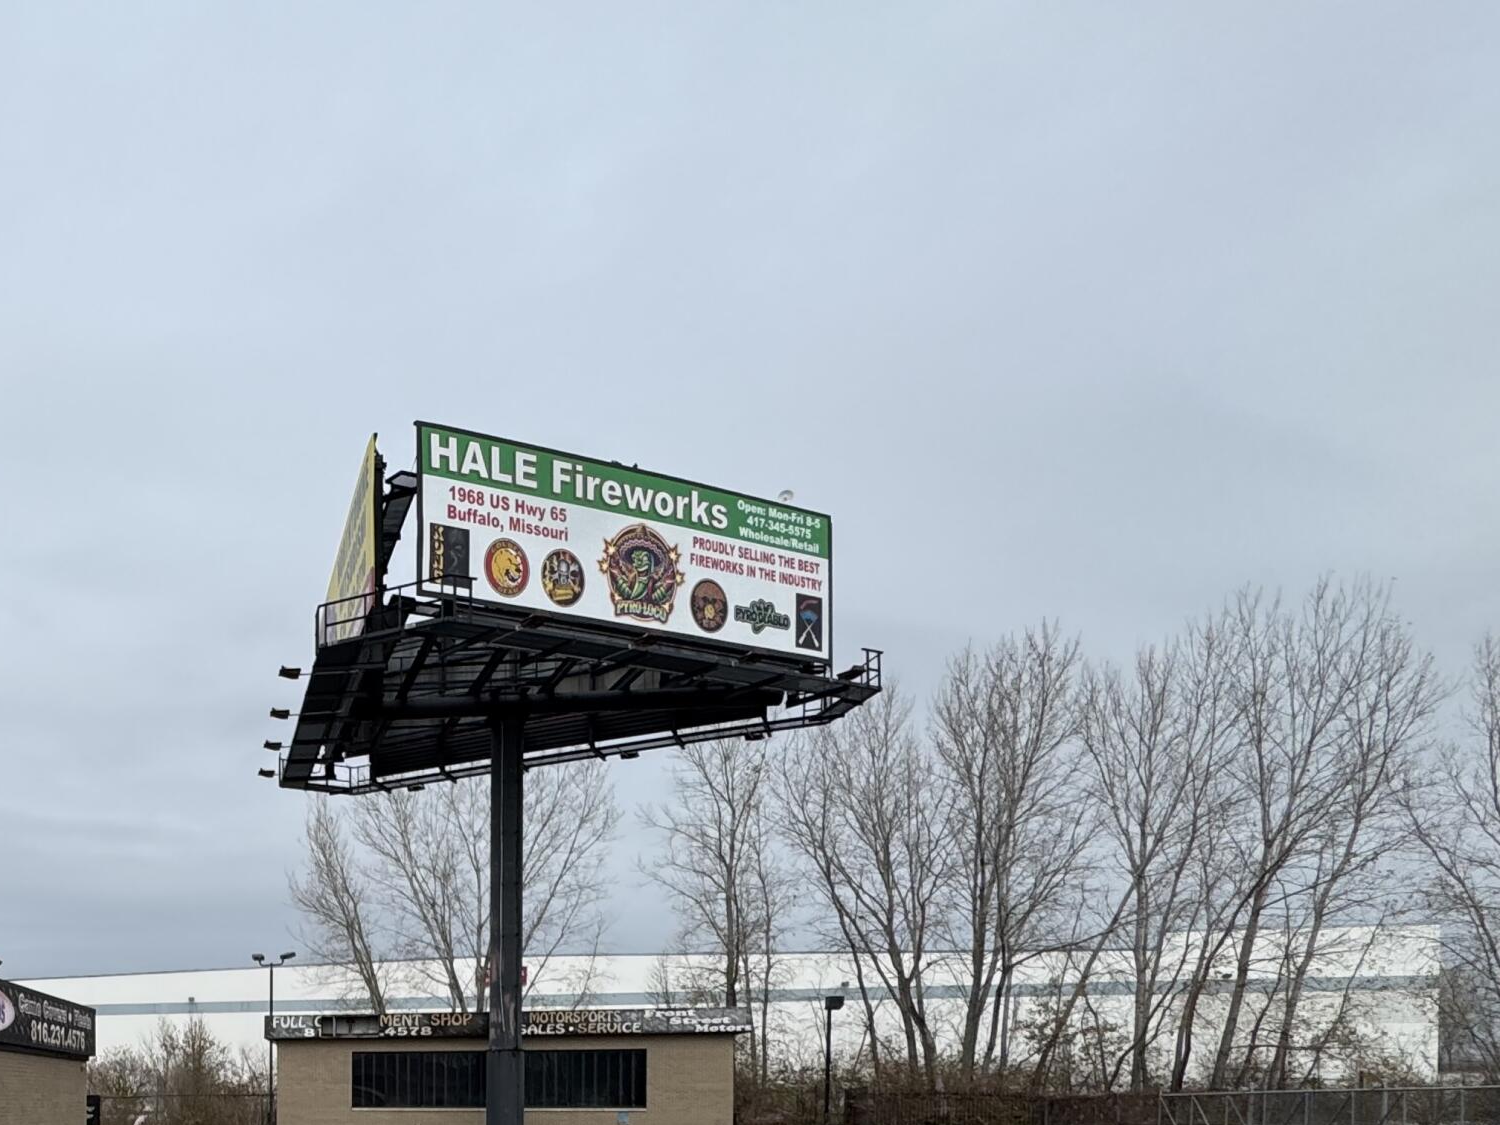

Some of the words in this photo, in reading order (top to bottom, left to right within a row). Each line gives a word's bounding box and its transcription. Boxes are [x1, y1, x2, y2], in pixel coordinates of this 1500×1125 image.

[430, 433, 537, 488] HALE
[552, 459, 728, 529] Fireworks
[449, 485, 484, 506] 1968
[490, 494, 510, 511] US
[515, 499, 546, 521] Hwy
[550, 507, 567, 522] 65
[737, 500, 766, 515] Open:
[768, 507, 804, 525] Mon-Fri
[806, 516, 821, 529] 8-5
[447, 504, 504, 532] Buffalo,
[509, 516, 568, 541] Missouri
[747, 515, 812, 540] 417-345-5575
[739, 526, 820, 554] Wholesale/Retail
[693, 536, 735, 557] PROUDLY
[738, 546, 775, 565] SELLING
[778, 555, 795, 570] THE
[798, 559, 820, 574] BEST
[690, 553, 744, 576] FIREWORKS
[747, 565, 756, 578] IN
[759, 567, 776, 582] THE
[779, 572, 822, 592] INDUSTRY
[273, 1016, 306, 1028] FULL
[430, 1013, 473, 1027] SHOP
[529, 1010, 622, 1024] MOTORSPORTS
[644, 1009, 696, 1018] Front
[669, 1016, 732, 1025] Street
[30, 1020, 85, 1050] 816.231.4576
[521, 1022, 566, 1035] SALES
[577, 1022, 642, 1035] SERVICE
[695, 1024, 752, 1033] Motors
